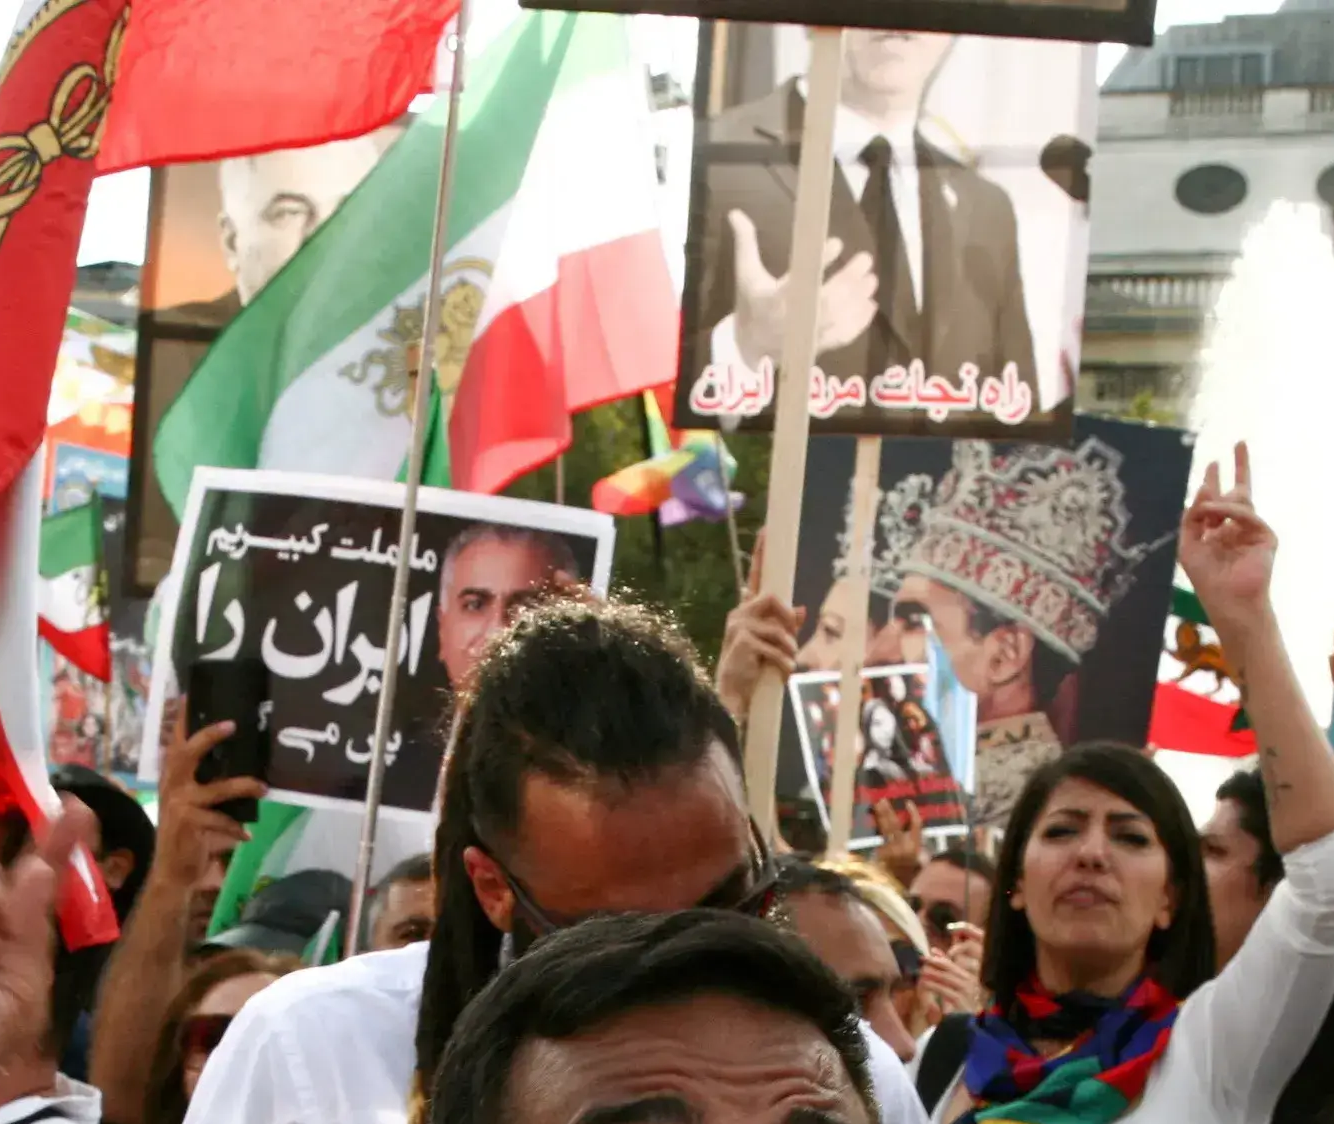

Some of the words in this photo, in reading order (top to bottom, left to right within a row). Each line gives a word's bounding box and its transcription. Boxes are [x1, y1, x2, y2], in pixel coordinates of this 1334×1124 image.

[689, 354, 775, 417] ایران
[808, 364, 867, 419] مرد
[869, 357, 979, 424] نجات
[979, 360, 1033, 425] راه
[330, 526, 400, 569] ملت
[408, 532, 438, 573] ما
[195, 561, 245, 661] را
[260, 579, 434, 706] ایران
[276, 721, 341, 764] می
